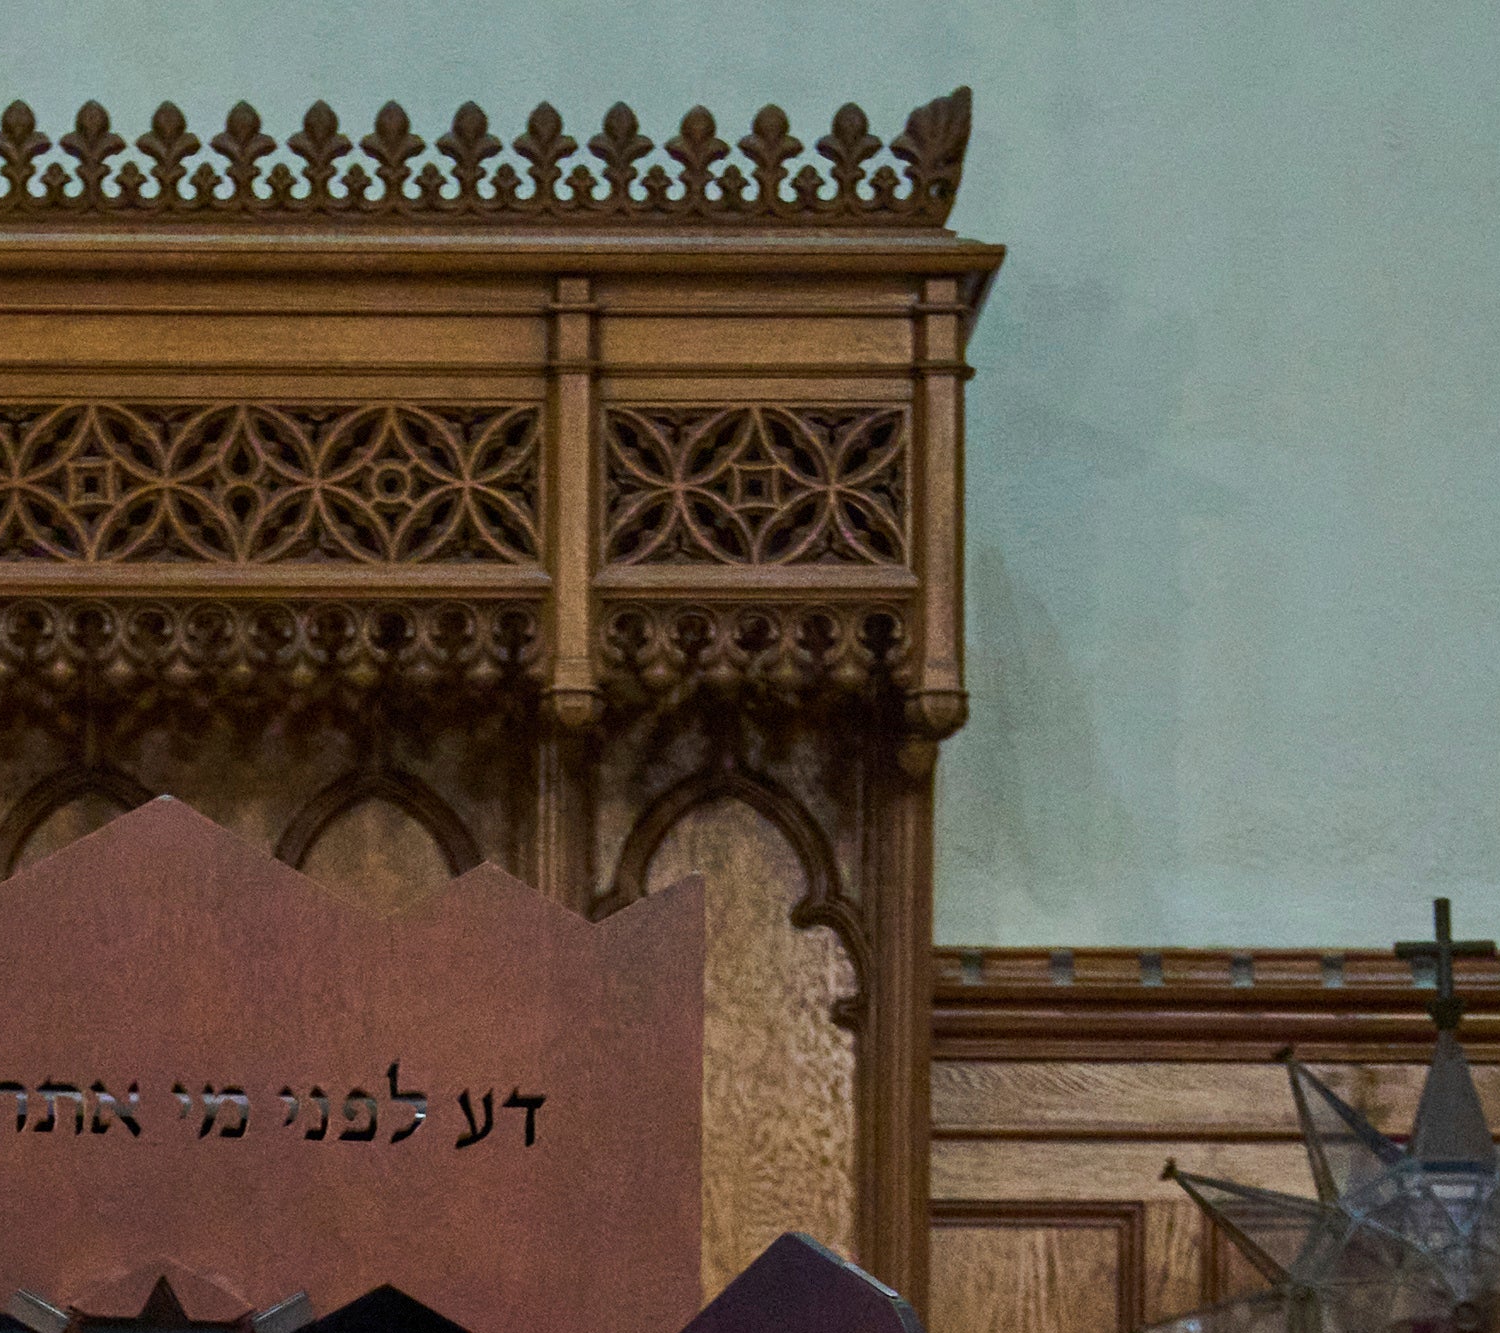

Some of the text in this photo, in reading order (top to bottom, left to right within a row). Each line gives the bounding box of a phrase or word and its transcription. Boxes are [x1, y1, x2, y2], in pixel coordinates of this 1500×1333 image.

[173, 1076, 251, 1139] מי
[278, 1059, 428, 1143] לפני
[455, 1087, 547, 1149] דע
